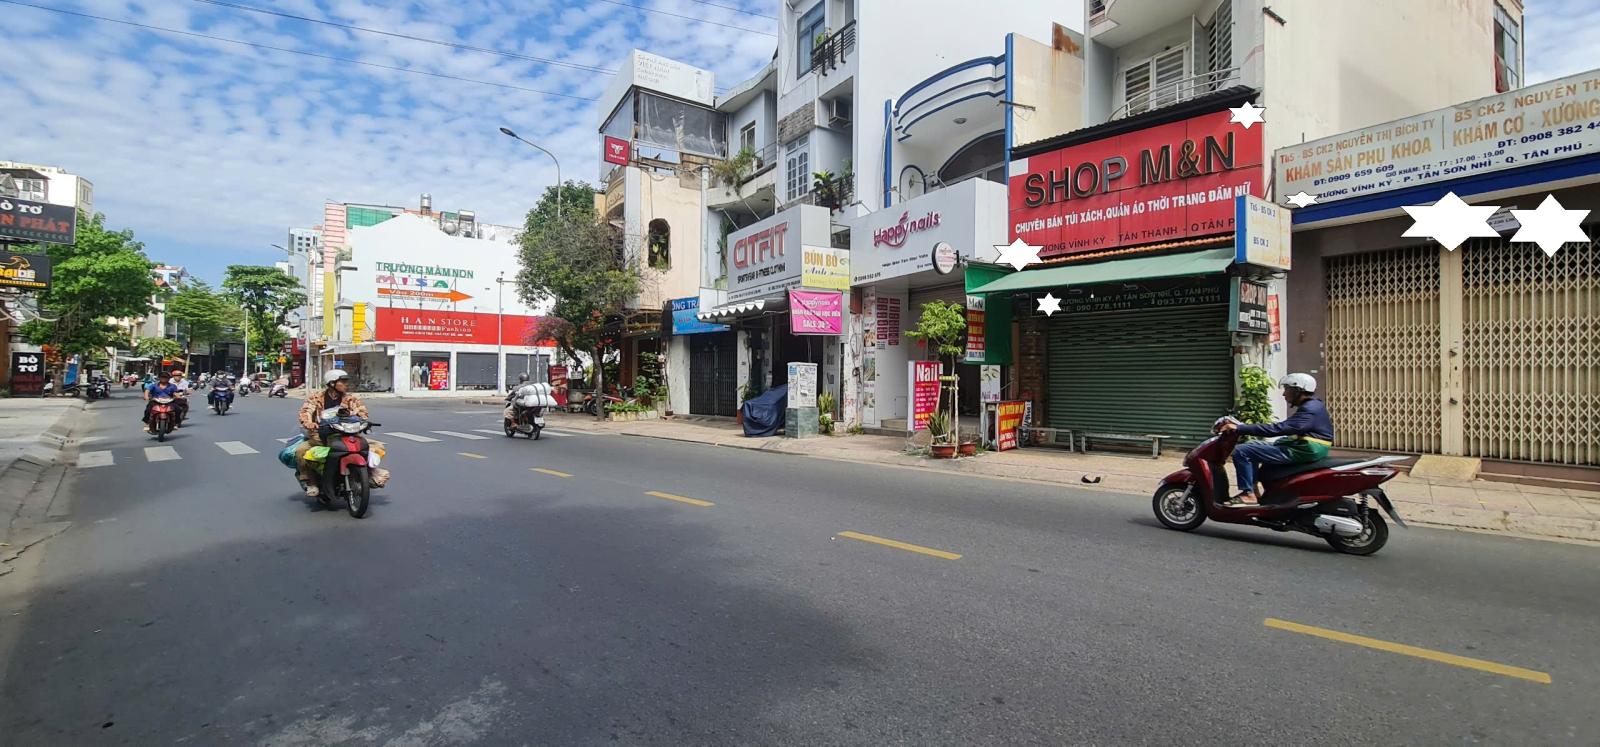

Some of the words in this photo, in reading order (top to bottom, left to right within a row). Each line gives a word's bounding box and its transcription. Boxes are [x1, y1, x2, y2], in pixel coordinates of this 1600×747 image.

[1455, 107, 1472, 122] BS
[1478, 101, 1505, 117] CK2
[1453, 119, 1497, 147] KHÁM
[1503, 111, 1525, 135] CƠ
[1520, 131, 1552, 144] 0908
[1557, 125, 1583, 137] 382
[1285, 159, 1322, 183] KHÁM
[1391, 136, 1432, 160] KHOA
[1316, 145, 1333, 156] CK2
[1025, 155, 1128, 208] SHOP
[1140, 131, 1236, 187] M&N
[1418, 169, 1440, 180] TÂN
[1443, 164, 1466, 175] SƠN
[1505, 156, 1518, 164] Q.
[1522, 148, 1549, 160] TÂN
[1554, 142, 1583, 154] PHÚ
[1328, 173, 1351, 184] 0909
[1354, 168, 1373, 178] 659
[1376, 164, 1395, 174] 609
[1015, 217, 1045, 234] CHUYÊN
[1046, 214, 1062, 228] BÁN
[1065, 210, 1078, 226] TÚI
[1132, 200, 1144, 214] ÁO
[1148, 196, 1169, 211] THỜI
[1172, 189, 1206, 206] TRANG
[441, 318, 477, 328] STORE
[18, 354, 38, 364] BÒ
[916, 364, 938, 382] Nail
